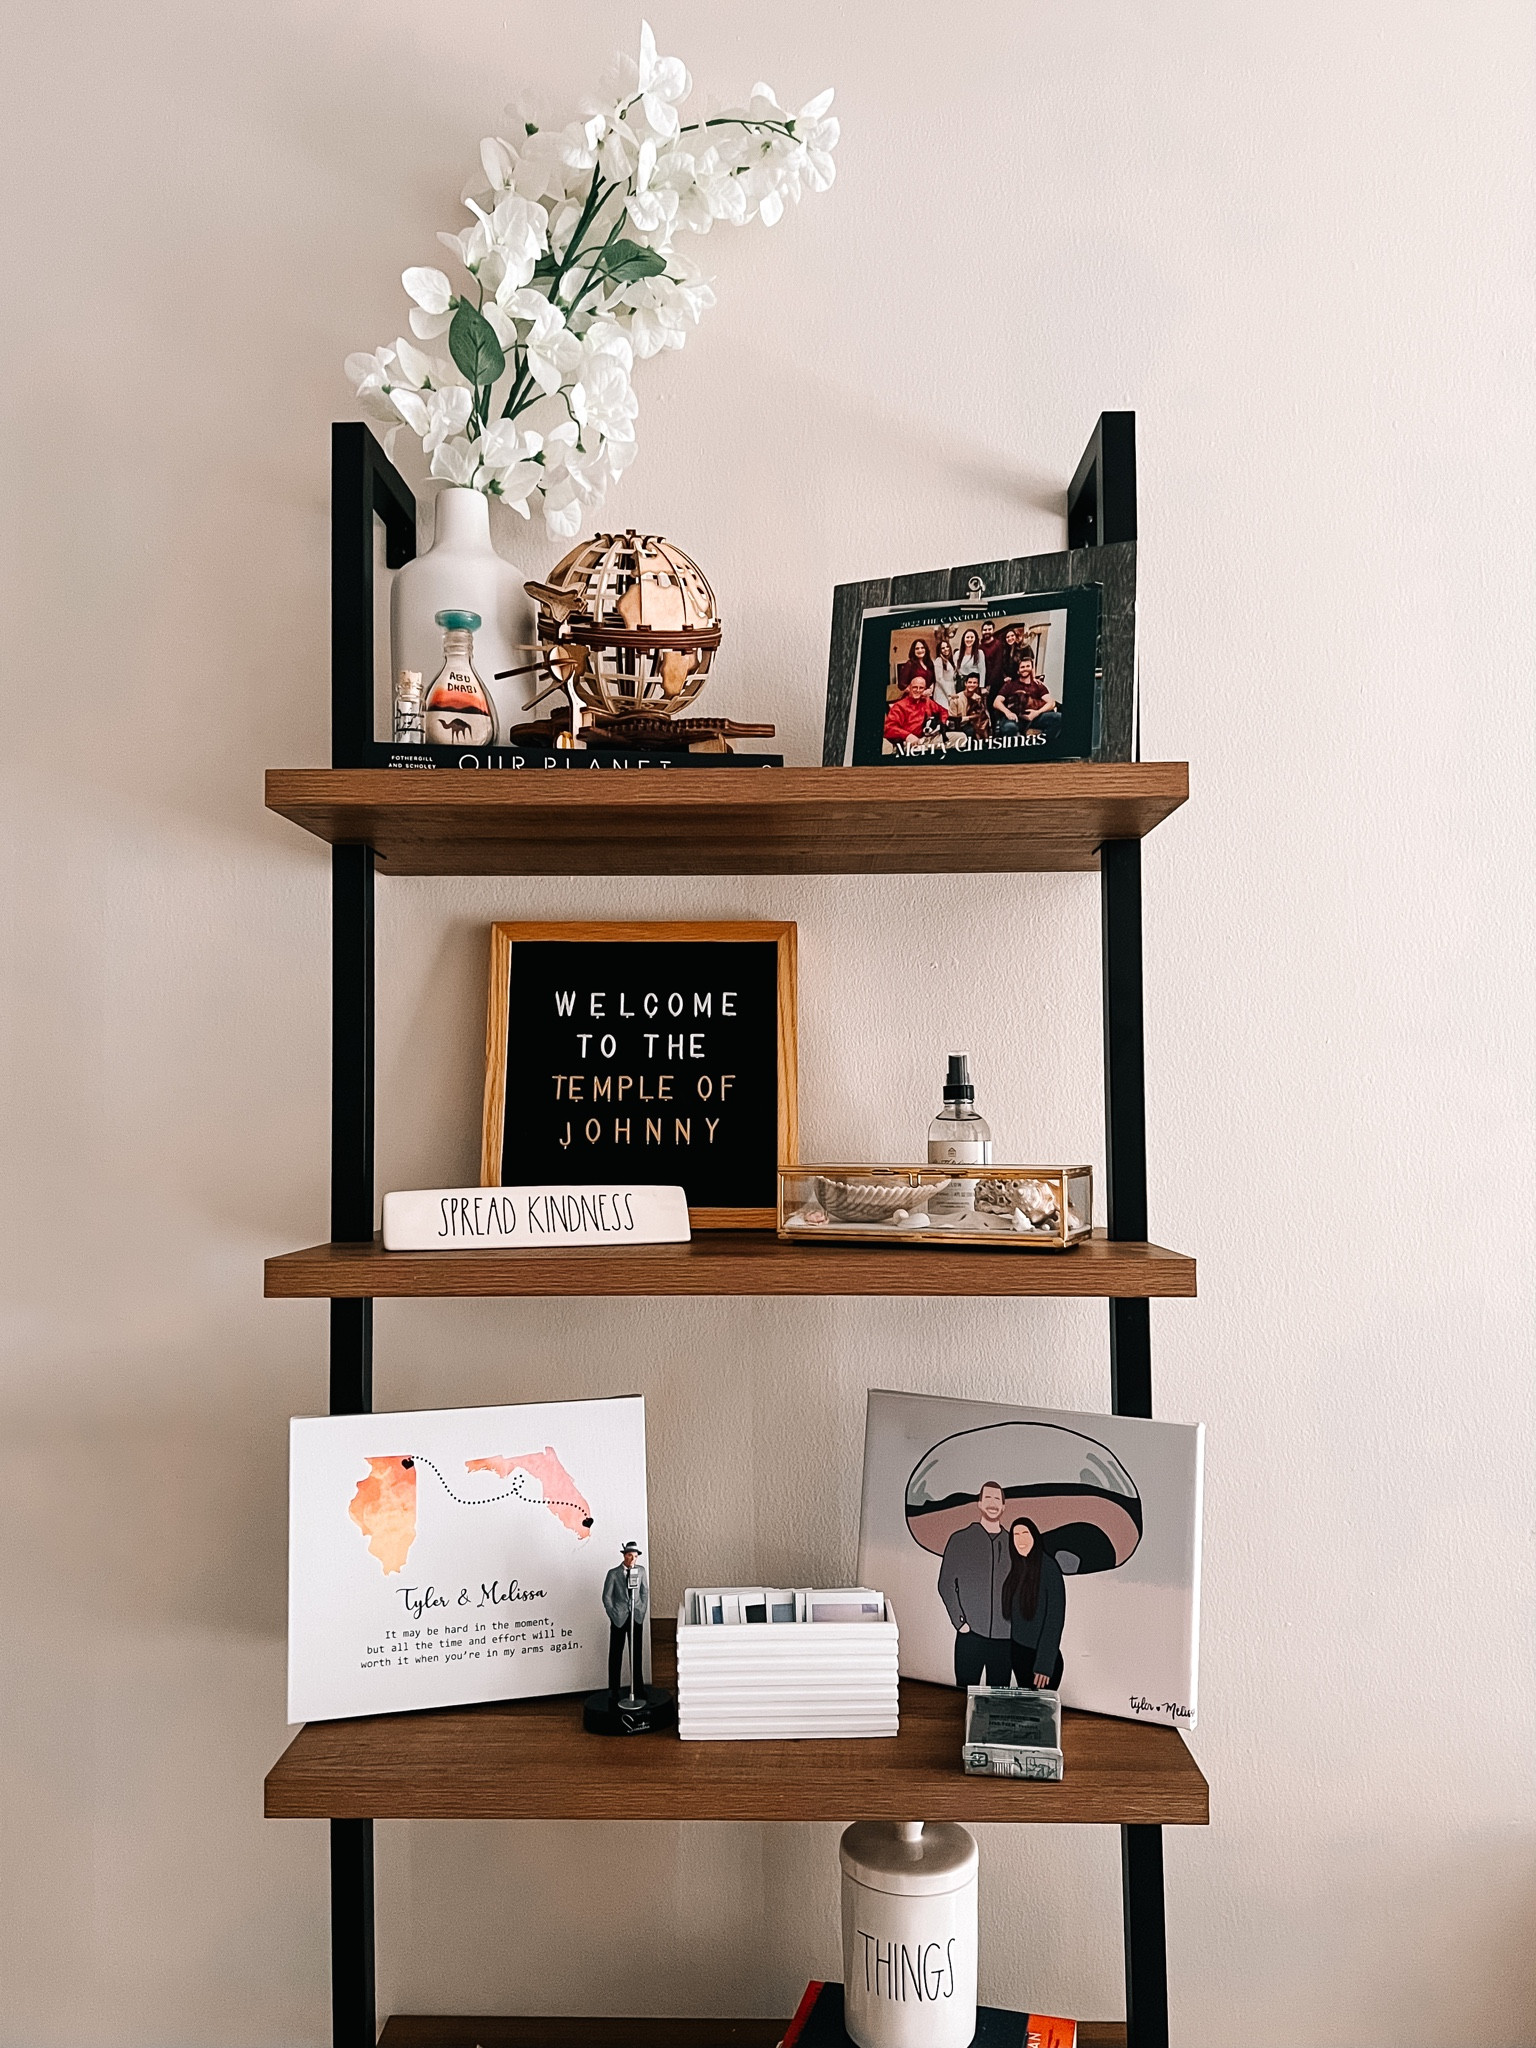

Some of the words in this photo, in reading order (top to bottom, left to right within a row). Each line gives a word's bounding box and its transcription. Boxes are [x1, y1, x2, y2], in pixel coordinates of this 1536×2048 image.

[900, 620, 920, 629] 2022
[923, 617, 937, 626] THE
[975, 609, 1007, 620] FAMILY
[447, 682, 477, 694] DHABI
[449, 671, 471, 683] ABU
[895, 742, 948, 760] Merry
[955, 732, 1047, 753] Christmas
[555, 990, 738, 1019] WELCOME
[577, 1033, 617, 1058] TO
[643, 1033, 705, 1060] THE
[552, 1075, 674, 1102] TEMPLE
[697, 1074, 736, 1101] OF
[559, 1117, 720, 1149] JOHNNY
[438, 1196, 517, 1237] SPREAD
[528, 1193, 634, 1234] KINDNESS
[395, 1586, 450, 1620] Tyler
[457, 1588, 472, 1606] &
[476, 1579, 548, 1608] Melissa
[367, 1645, 384, 1654] but
[391, 1642, 409, 1652] all
[415, 1641, 433, 1650] the
[439, 1638, 463, 1648] time
[468, 1636, 486, 1646] and
[491, 1633, 527, 1644] effort
[532, 1629, 555, 1640] will
[561, 1628, 573, 1638] be
[385, 1630, 397, 1639] It
[402, 1629, 421, 1639] may
[427, 1627, 439, 1636] be
[444, 1624, 469, 1634] hard
[475, 1622, 486, 1632] in
[492, 1621, 510, 1630] the
[514, 1617, 554, 1628] moment,
[360, 1658, 391, 1669] worth
[397, 1656, 409, 1665] it
[415, 1654, 439, 1664] when
[487, 1648, 498, 1658] in
[503, 1648, 515, 1658] my
[521, 1645, 544, 1654] arms
[550, 1640, 583, 1653] again.
[857, 1929, 956, 2002] THINGS
